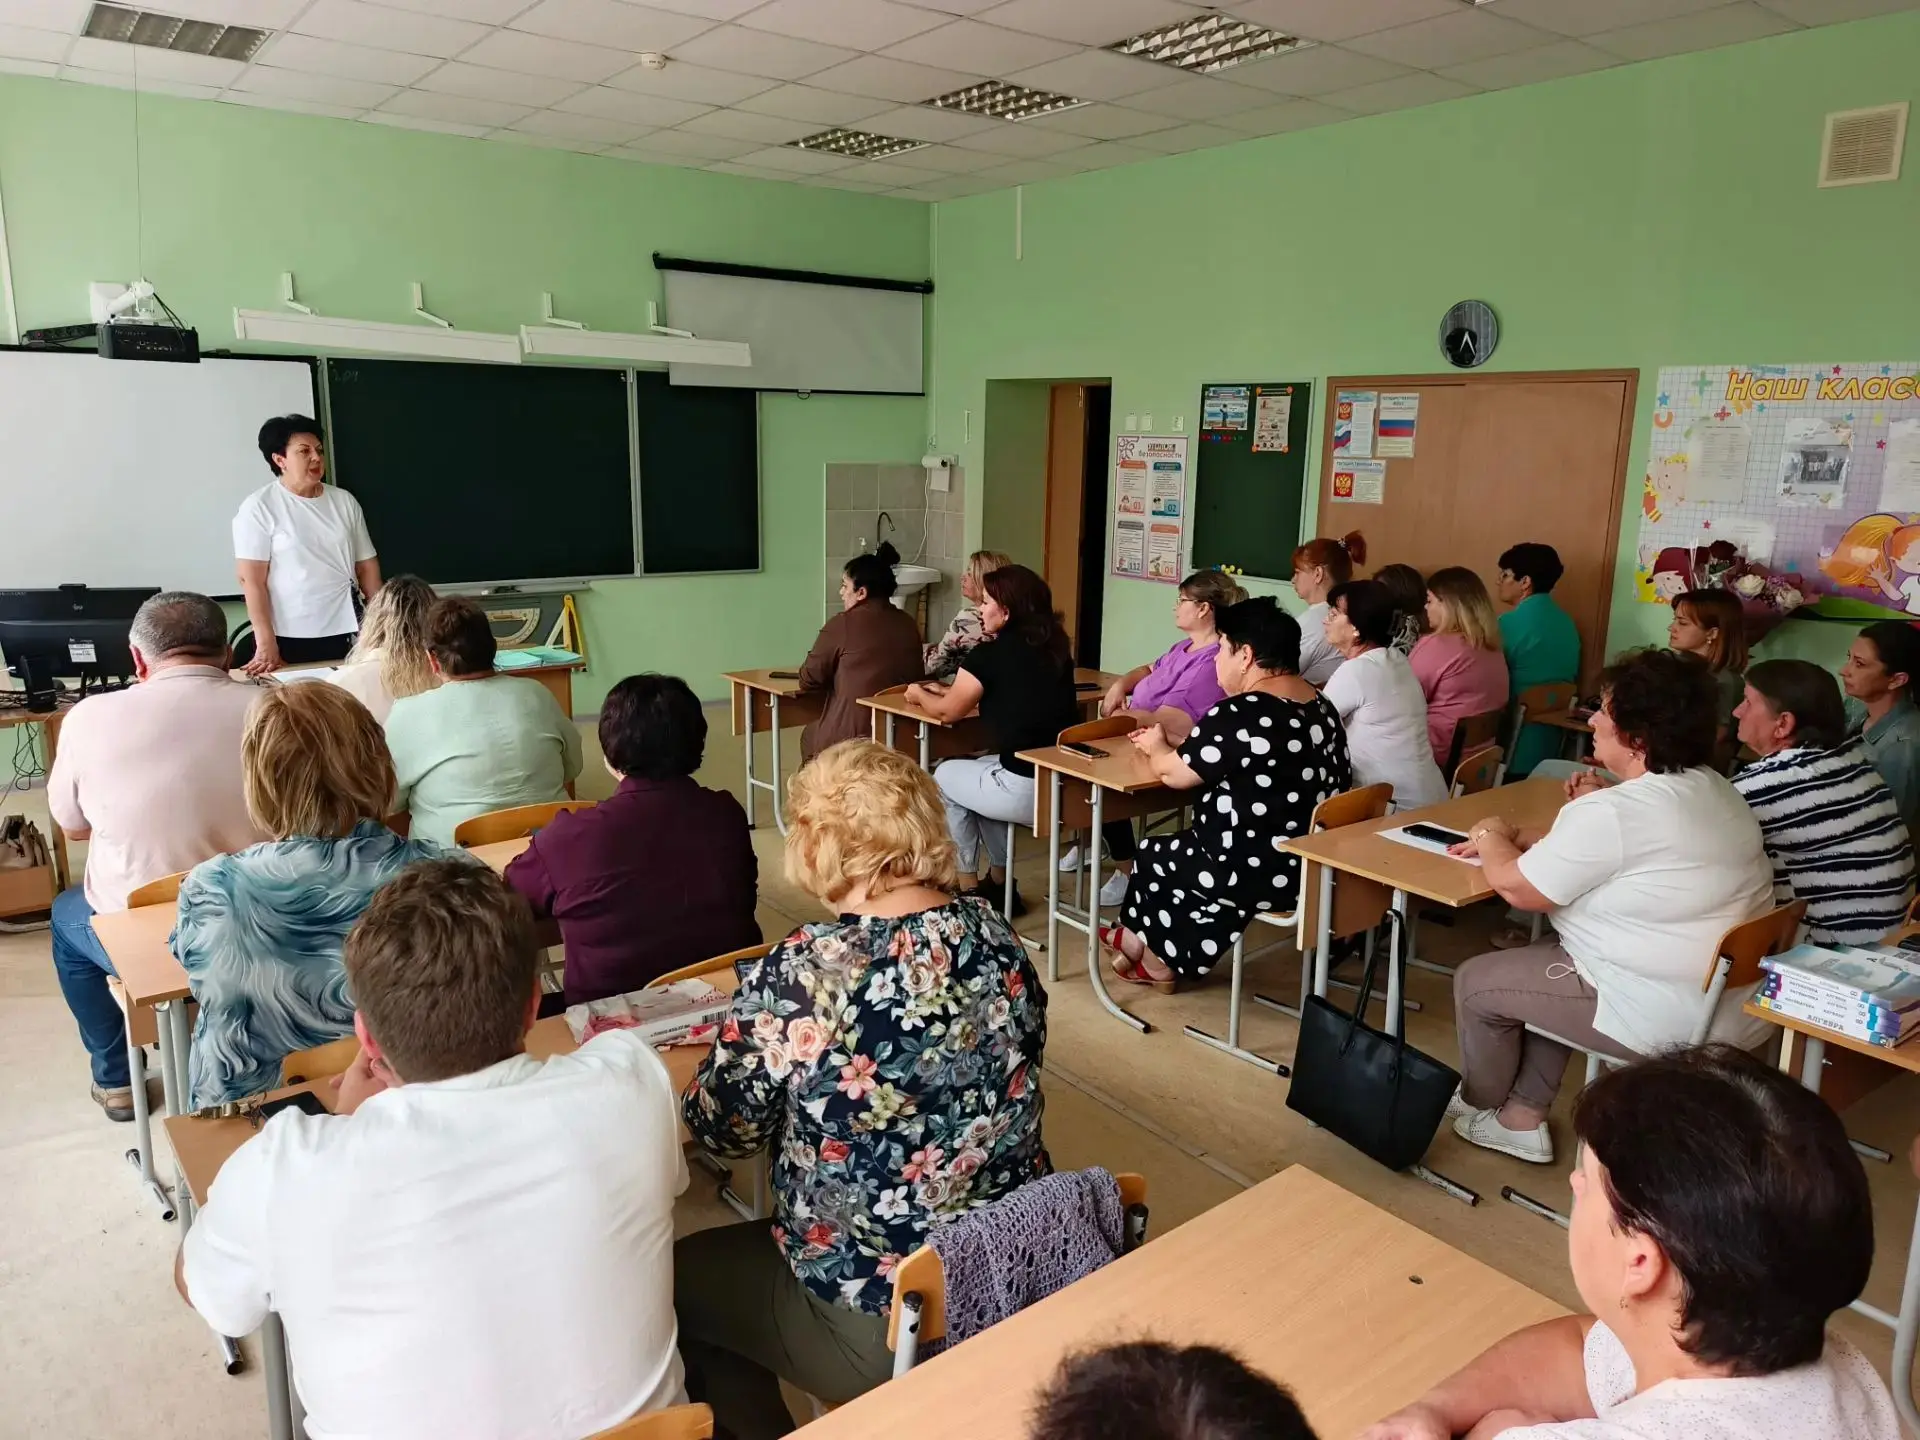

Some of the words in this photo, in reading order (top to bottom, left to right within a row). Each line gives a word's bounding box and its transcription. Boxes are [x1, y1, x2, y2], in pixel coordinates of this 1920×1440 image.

[1726, 372, 1809, 400] Наш
[1817, 376, 1920, 400] клас
[1167, 504, 1176, 512] 02
[1128, 562, 1141, 571] 112
[1807, 1014, 1844, 1031] АЛГЕБРА
